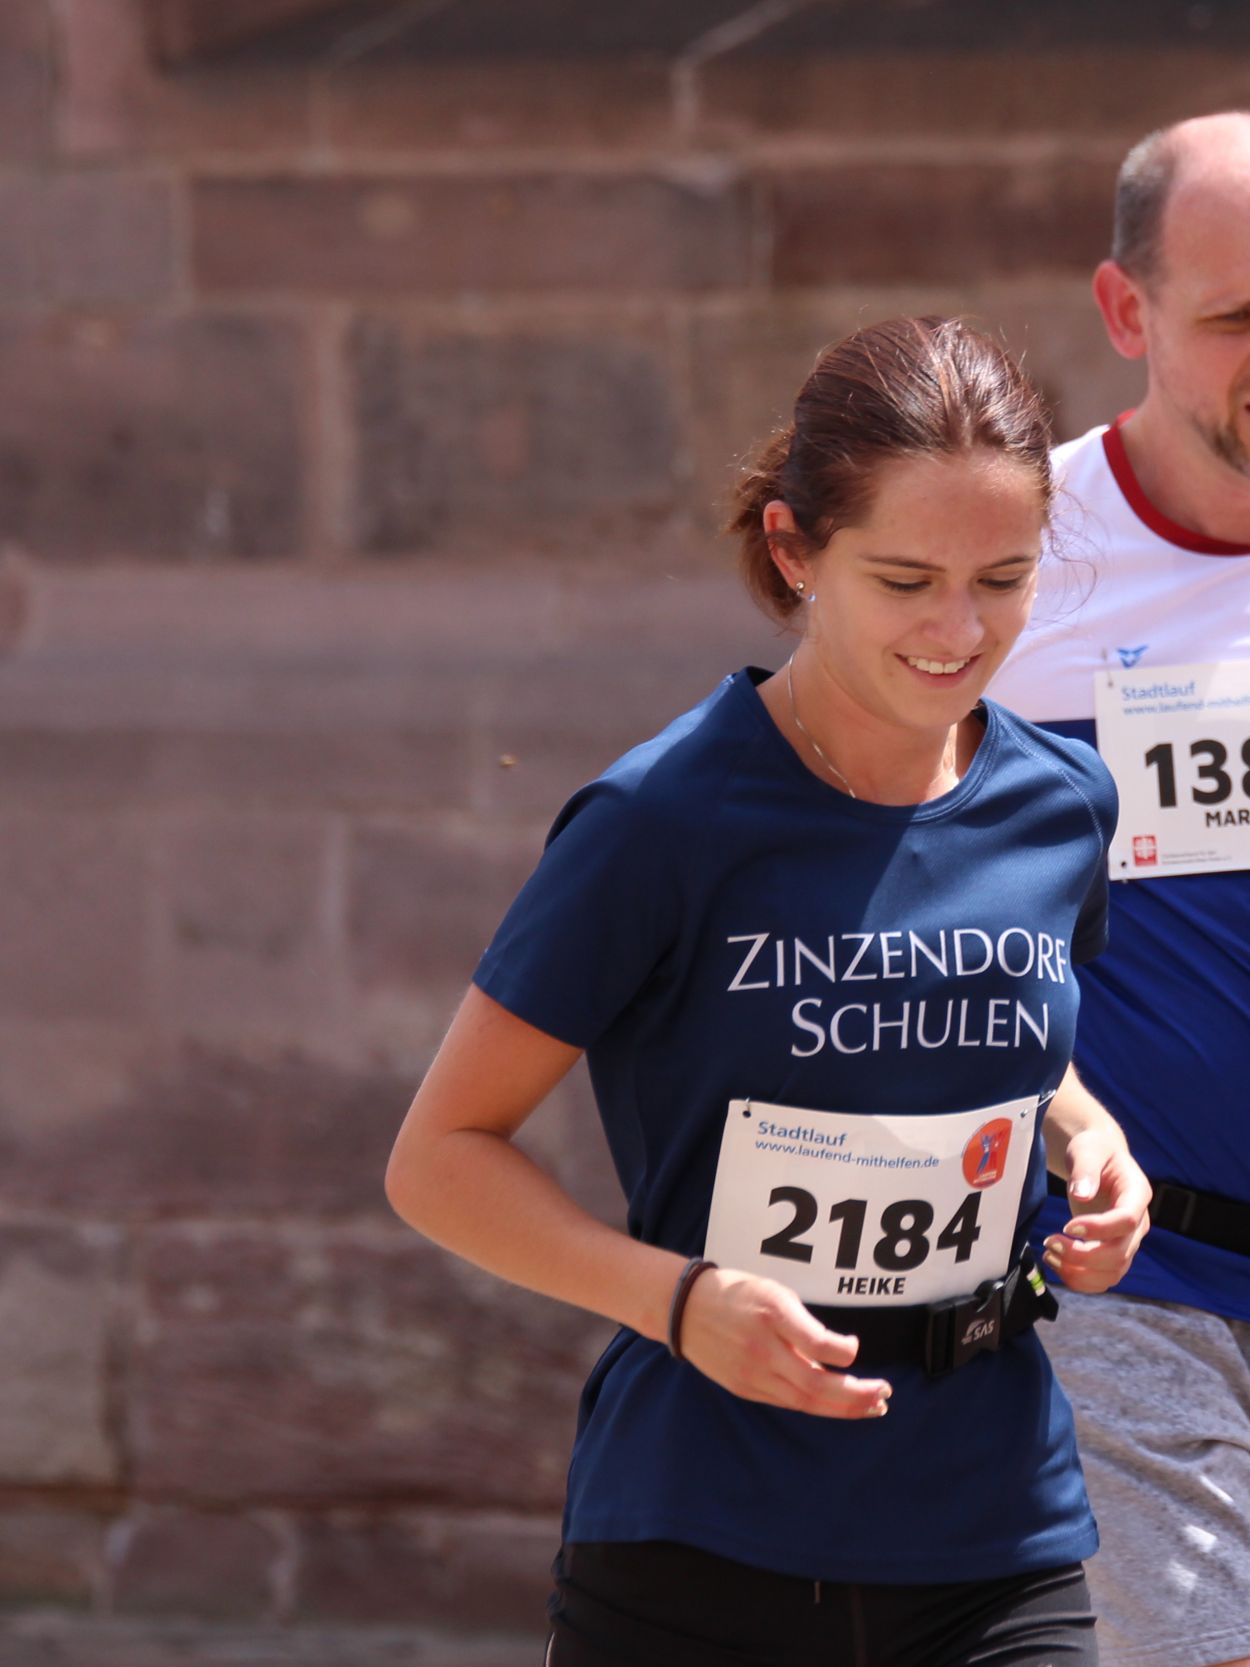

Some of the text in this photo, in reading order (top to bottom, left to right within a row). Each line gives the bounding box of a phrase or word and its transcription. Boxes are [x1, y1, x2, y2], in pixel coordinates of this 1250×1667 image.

[1121, 682, 1197, 701] Stadtlauf
[726, 926, 1068, 993] ZINZENDORF
[790, 997, 1050, 1057] SCHULEN
[758, 1120, 848, 1147] Stadtlauf
[754, 1139, 940, 1170] www.laufend-mithelfen.de
[759, 1185, 983, 1271] 2184
[836, 1275, 907, 1297] HEIKE
